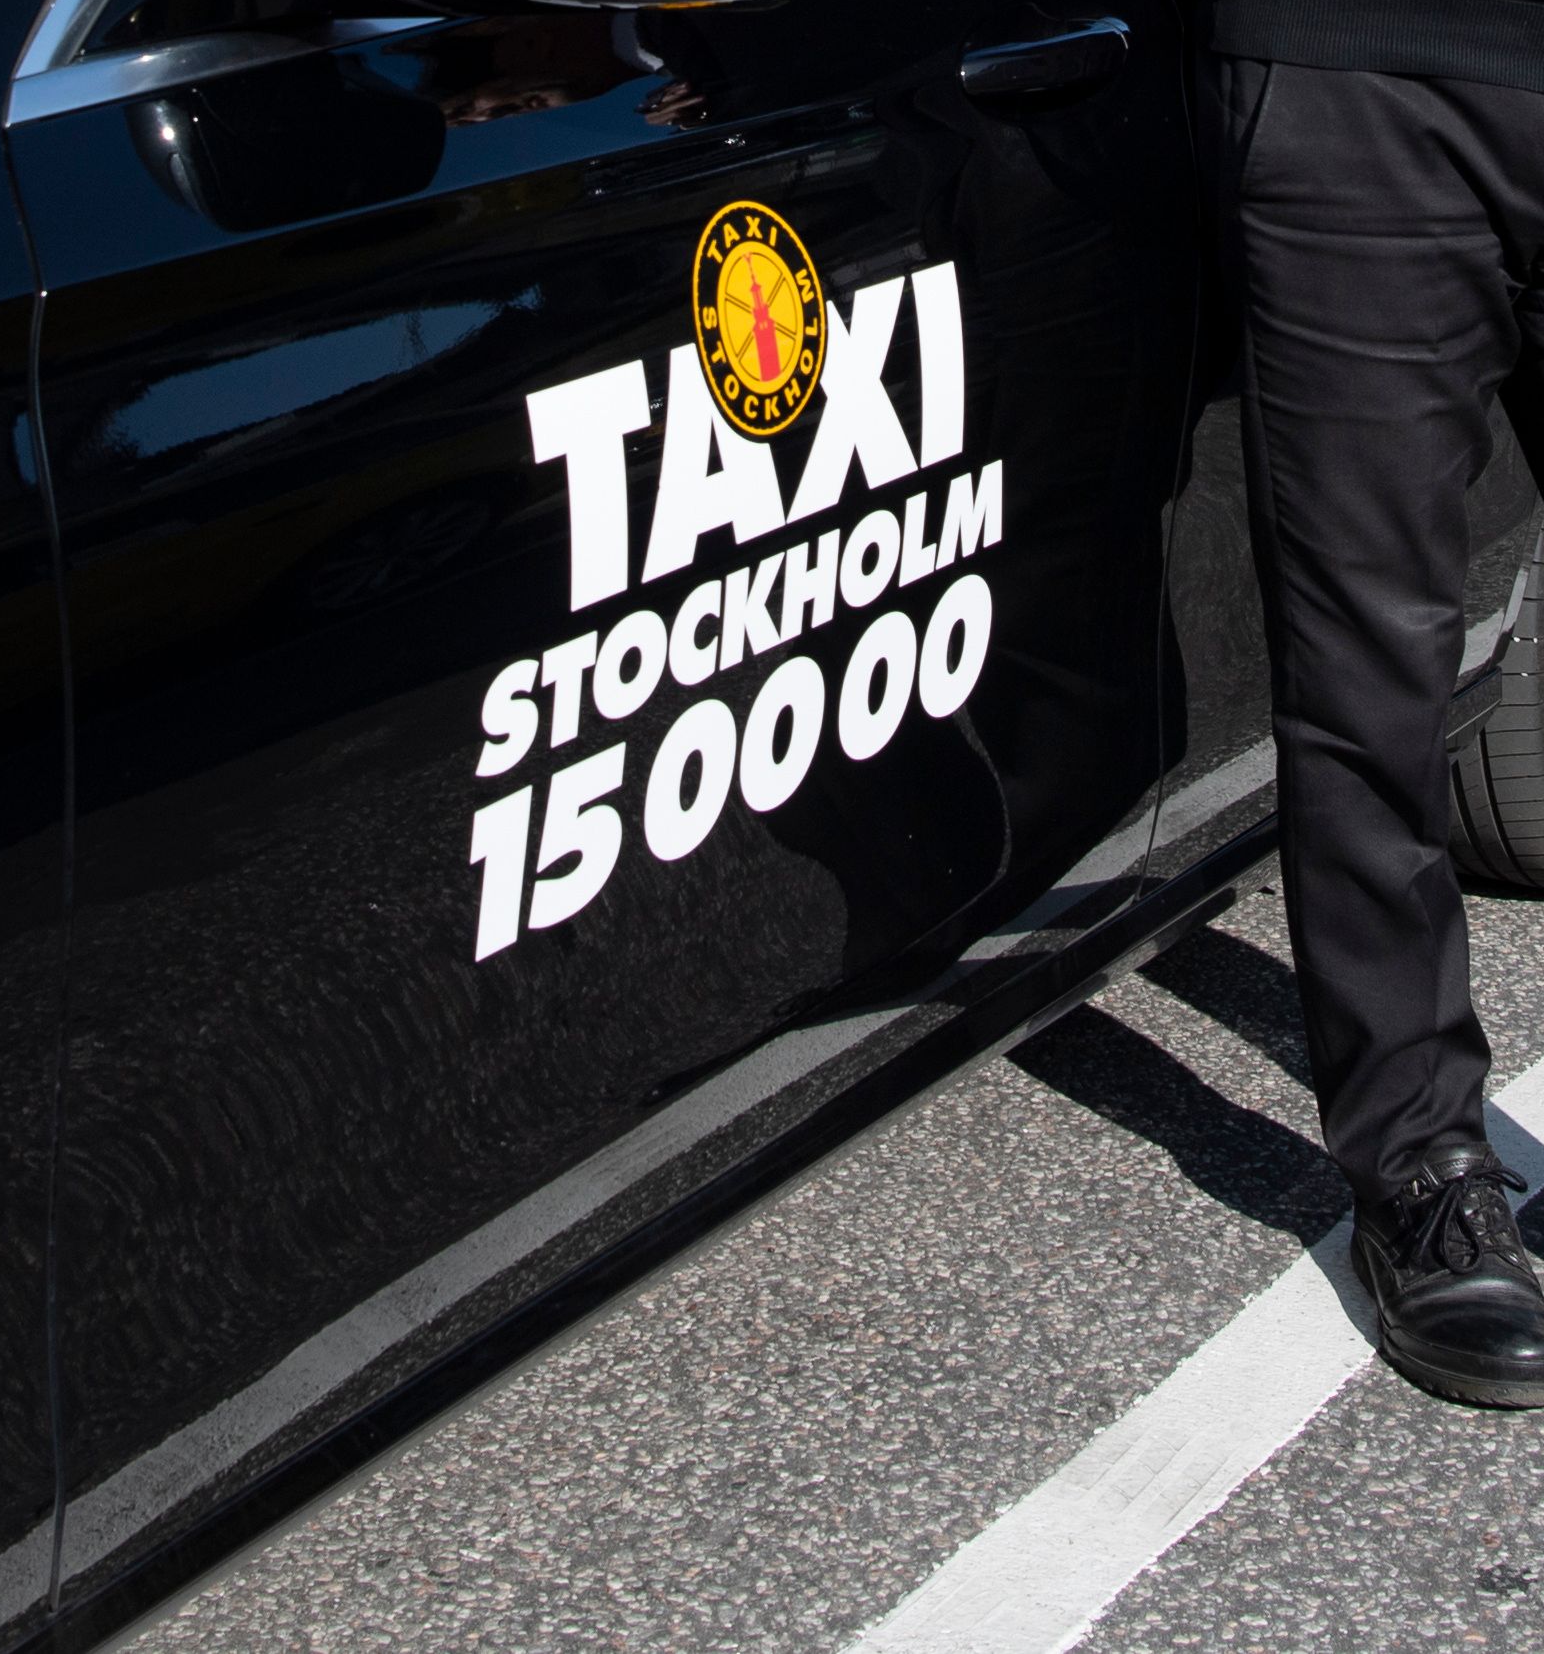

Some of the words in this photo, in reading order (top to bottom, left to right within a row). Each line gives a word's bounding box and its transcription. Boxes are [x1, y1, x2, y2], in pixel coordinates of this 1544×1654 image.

[702, 268, 816, 421] STOCKHOLM
[706, 214, 778, 265] TAXI
[526, 260, 965, 612] TAXI
[475, 459, 1003, 777] STOCKHOLM
